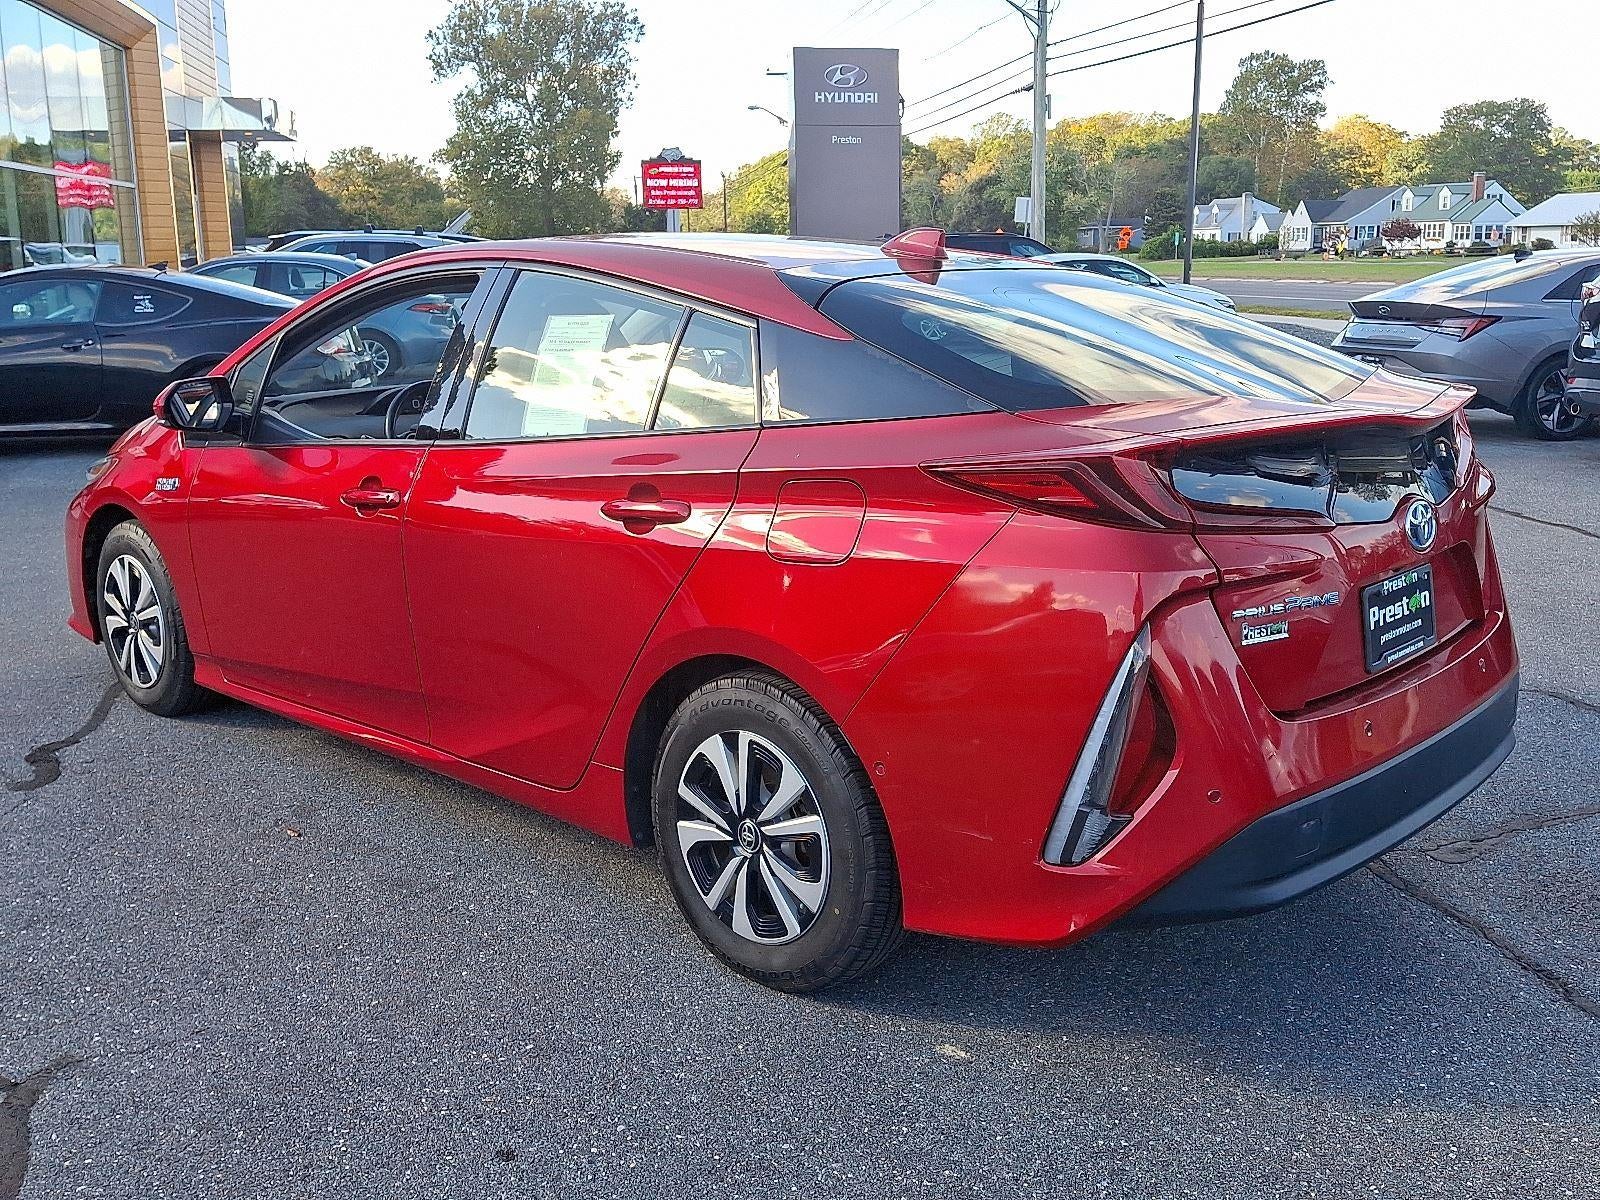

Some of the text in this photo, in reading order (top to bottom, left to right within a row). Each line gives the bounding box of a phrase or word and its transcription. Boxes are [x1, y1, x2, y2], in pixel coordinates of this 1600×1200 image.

[814, 91, 879, 104] HYUNDAI
[831, 135, 862, 145] Preston
[646, 178, 699, 187] NOW HIRING
[1231, 591, 1340, 621] PRIUS PRIME
[1369, 589, 1431, 631] Preston
[688, 696, 791, 730] Advantage
